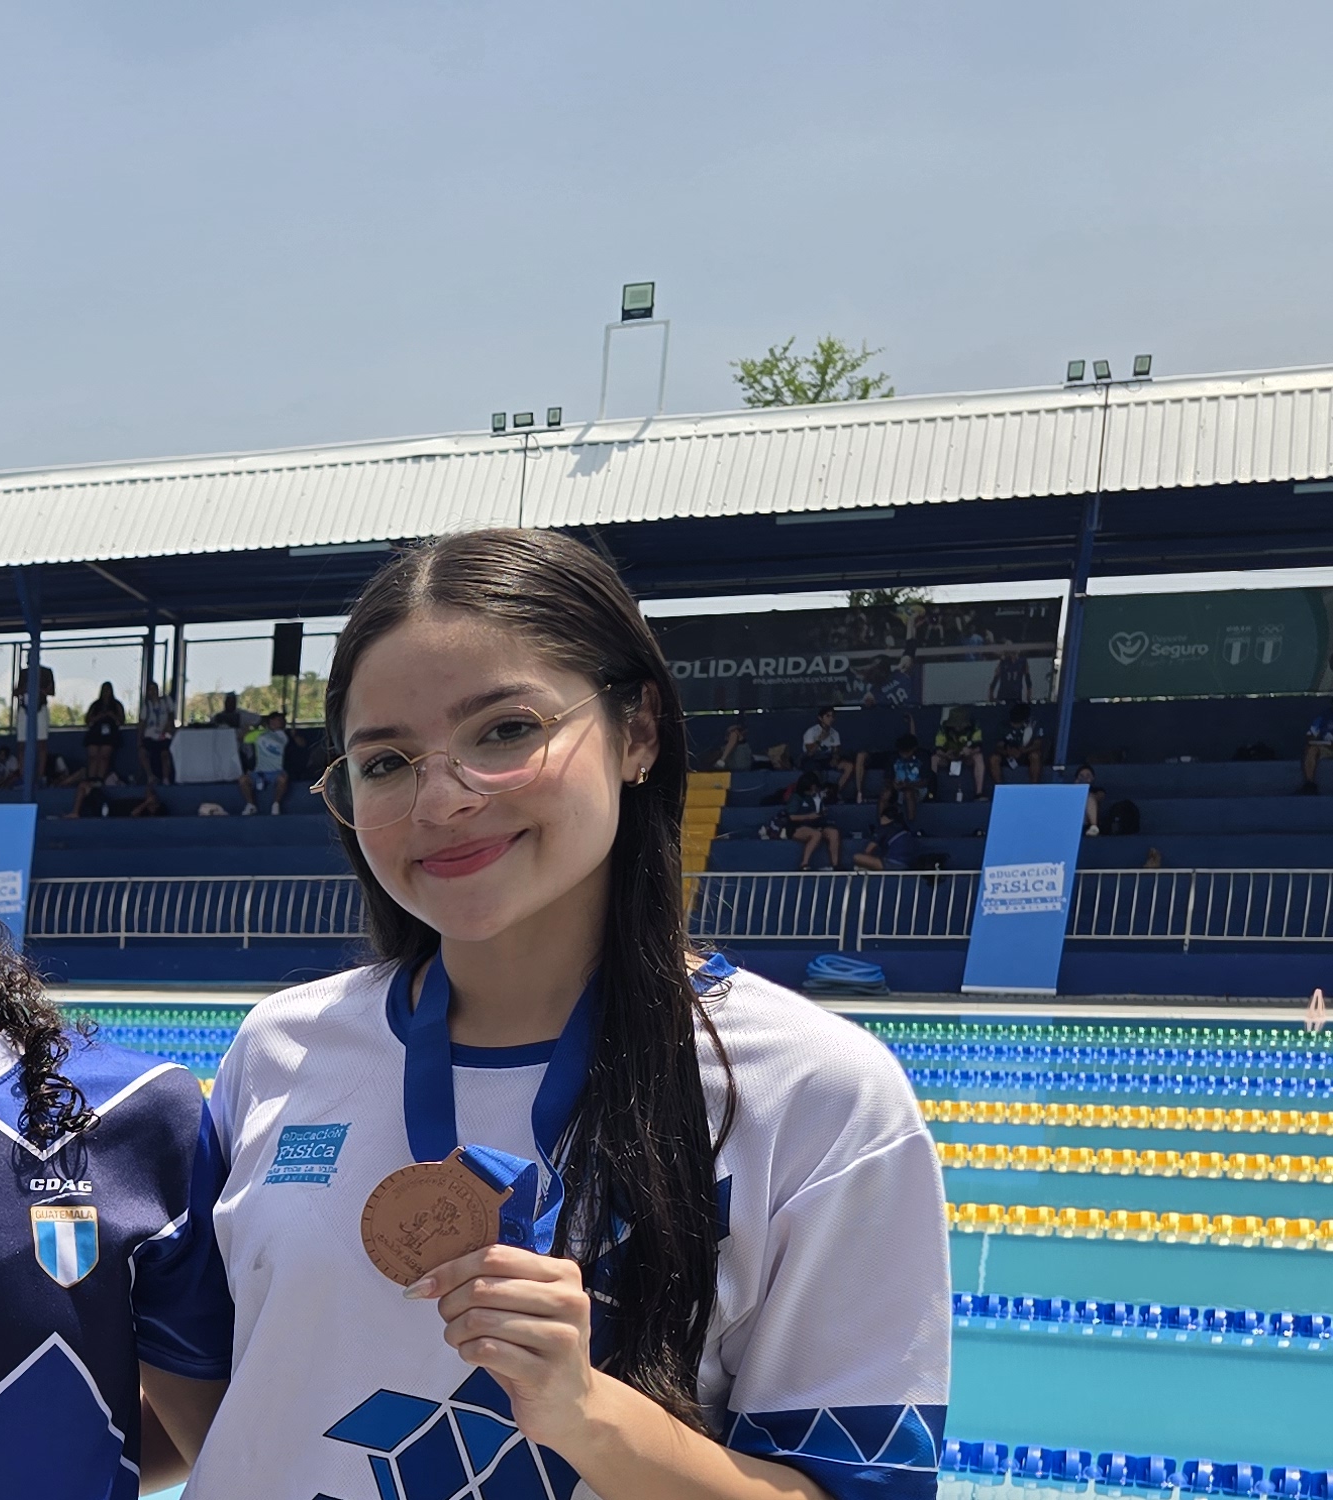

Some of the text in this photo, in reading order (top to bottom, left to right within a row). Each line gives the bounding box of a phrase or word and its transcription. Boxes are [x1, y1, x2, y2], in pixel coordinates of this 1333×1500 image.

[1151, 643, 1209, 659] Seguro
[29, 1178, 92, 1193] CDAG
[35, 1210, 93, 1220] GUATEMALA
